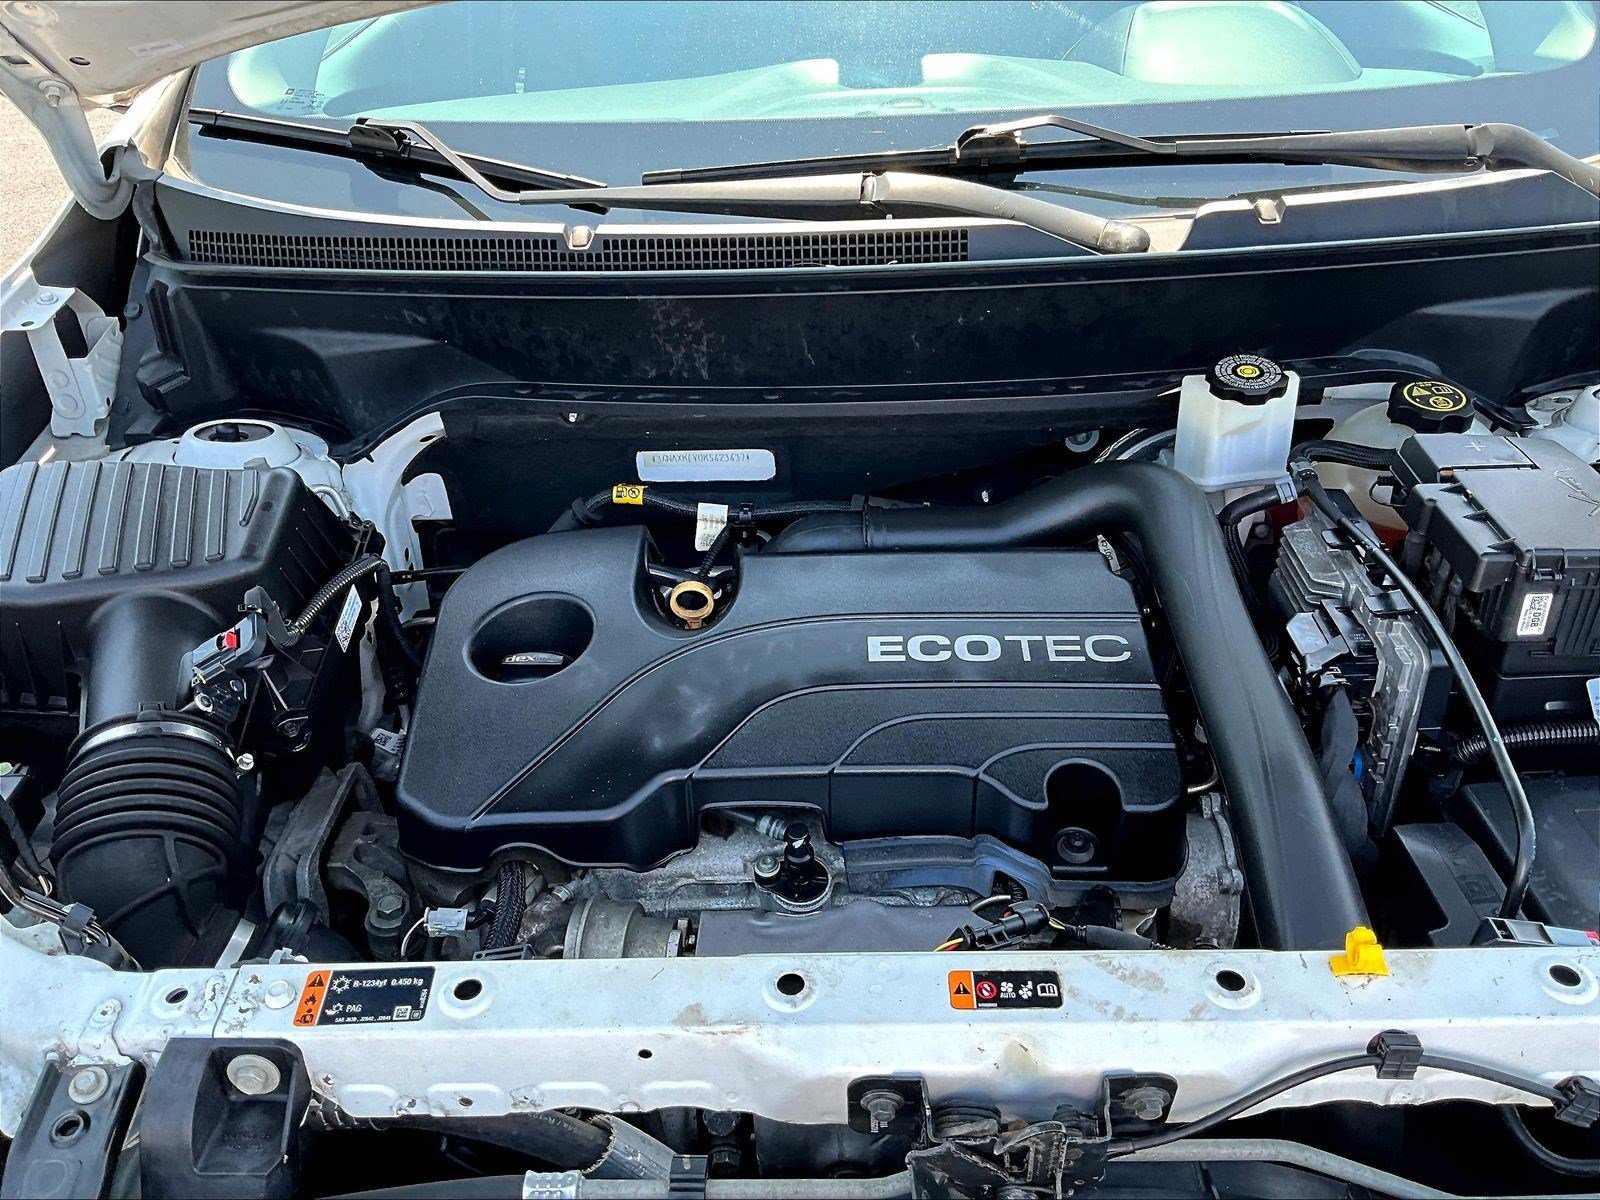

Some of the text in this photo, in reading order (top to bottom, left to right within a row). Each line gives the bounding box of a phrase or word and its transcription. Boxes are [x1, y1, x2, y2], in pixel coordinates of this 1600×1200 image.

[867, 635, 1131, 662] ECOTEC
[353, 978, 424, 988] R-1234yf 0.450 kg
[346, 1004, 362, 1013] PAG
